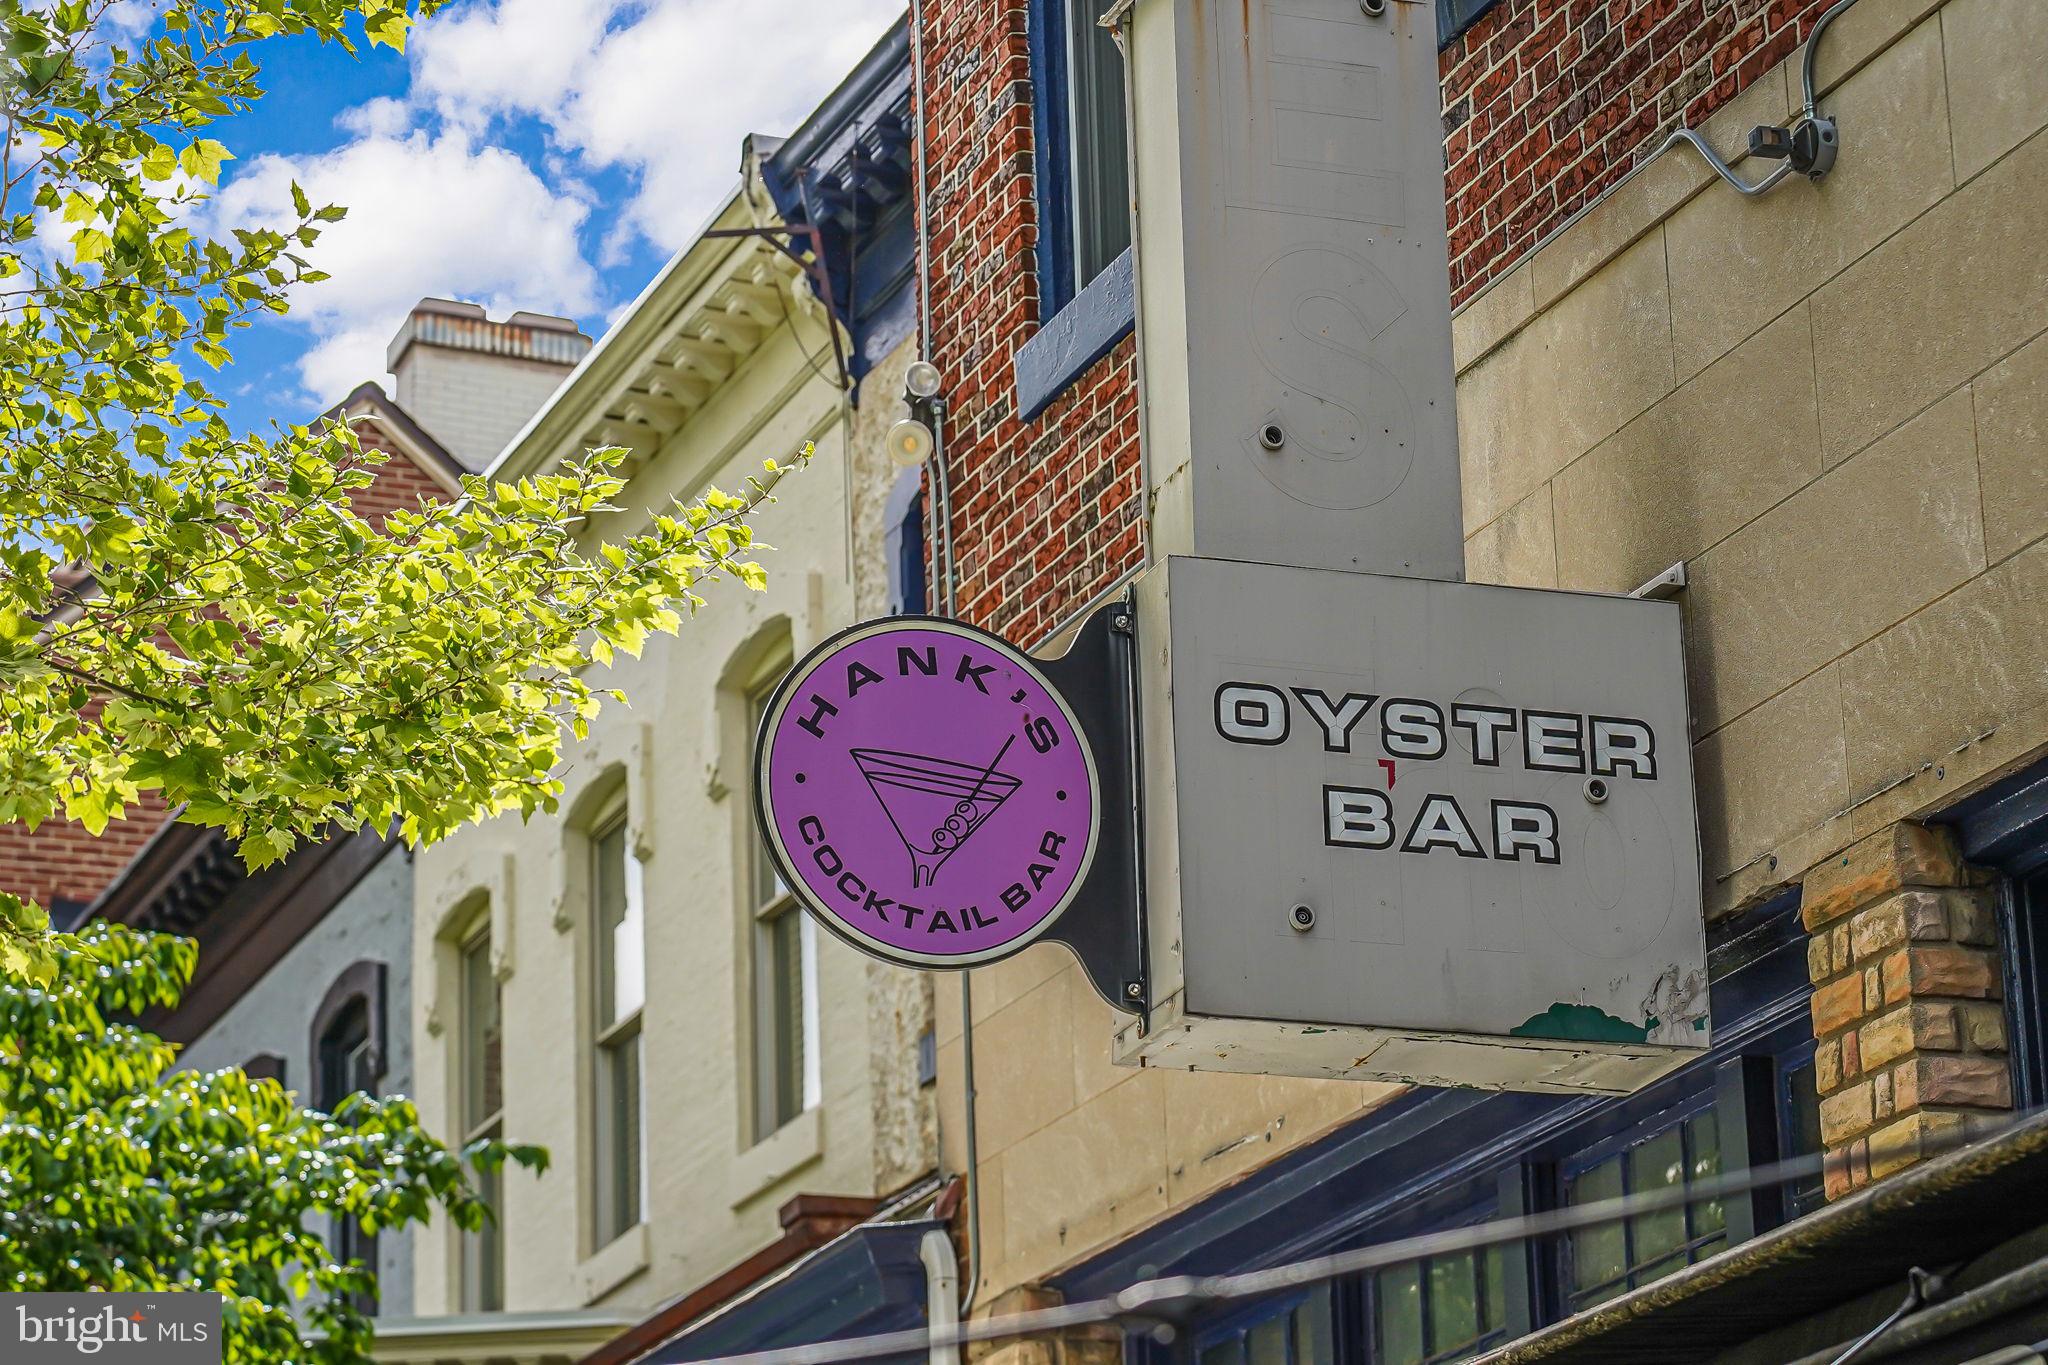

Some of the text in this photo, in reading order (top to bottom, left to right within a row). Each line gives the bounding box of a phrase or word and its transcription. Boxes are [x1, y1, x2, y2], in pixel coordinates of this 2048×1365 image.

[794, 646, 1060, 754] HANK'S
[1213, 681, 1658, 781] OYSTER
[797, 815, 1067, 934] COCKTAIL BAR
[1322, 783, 1561, 865] BAR
